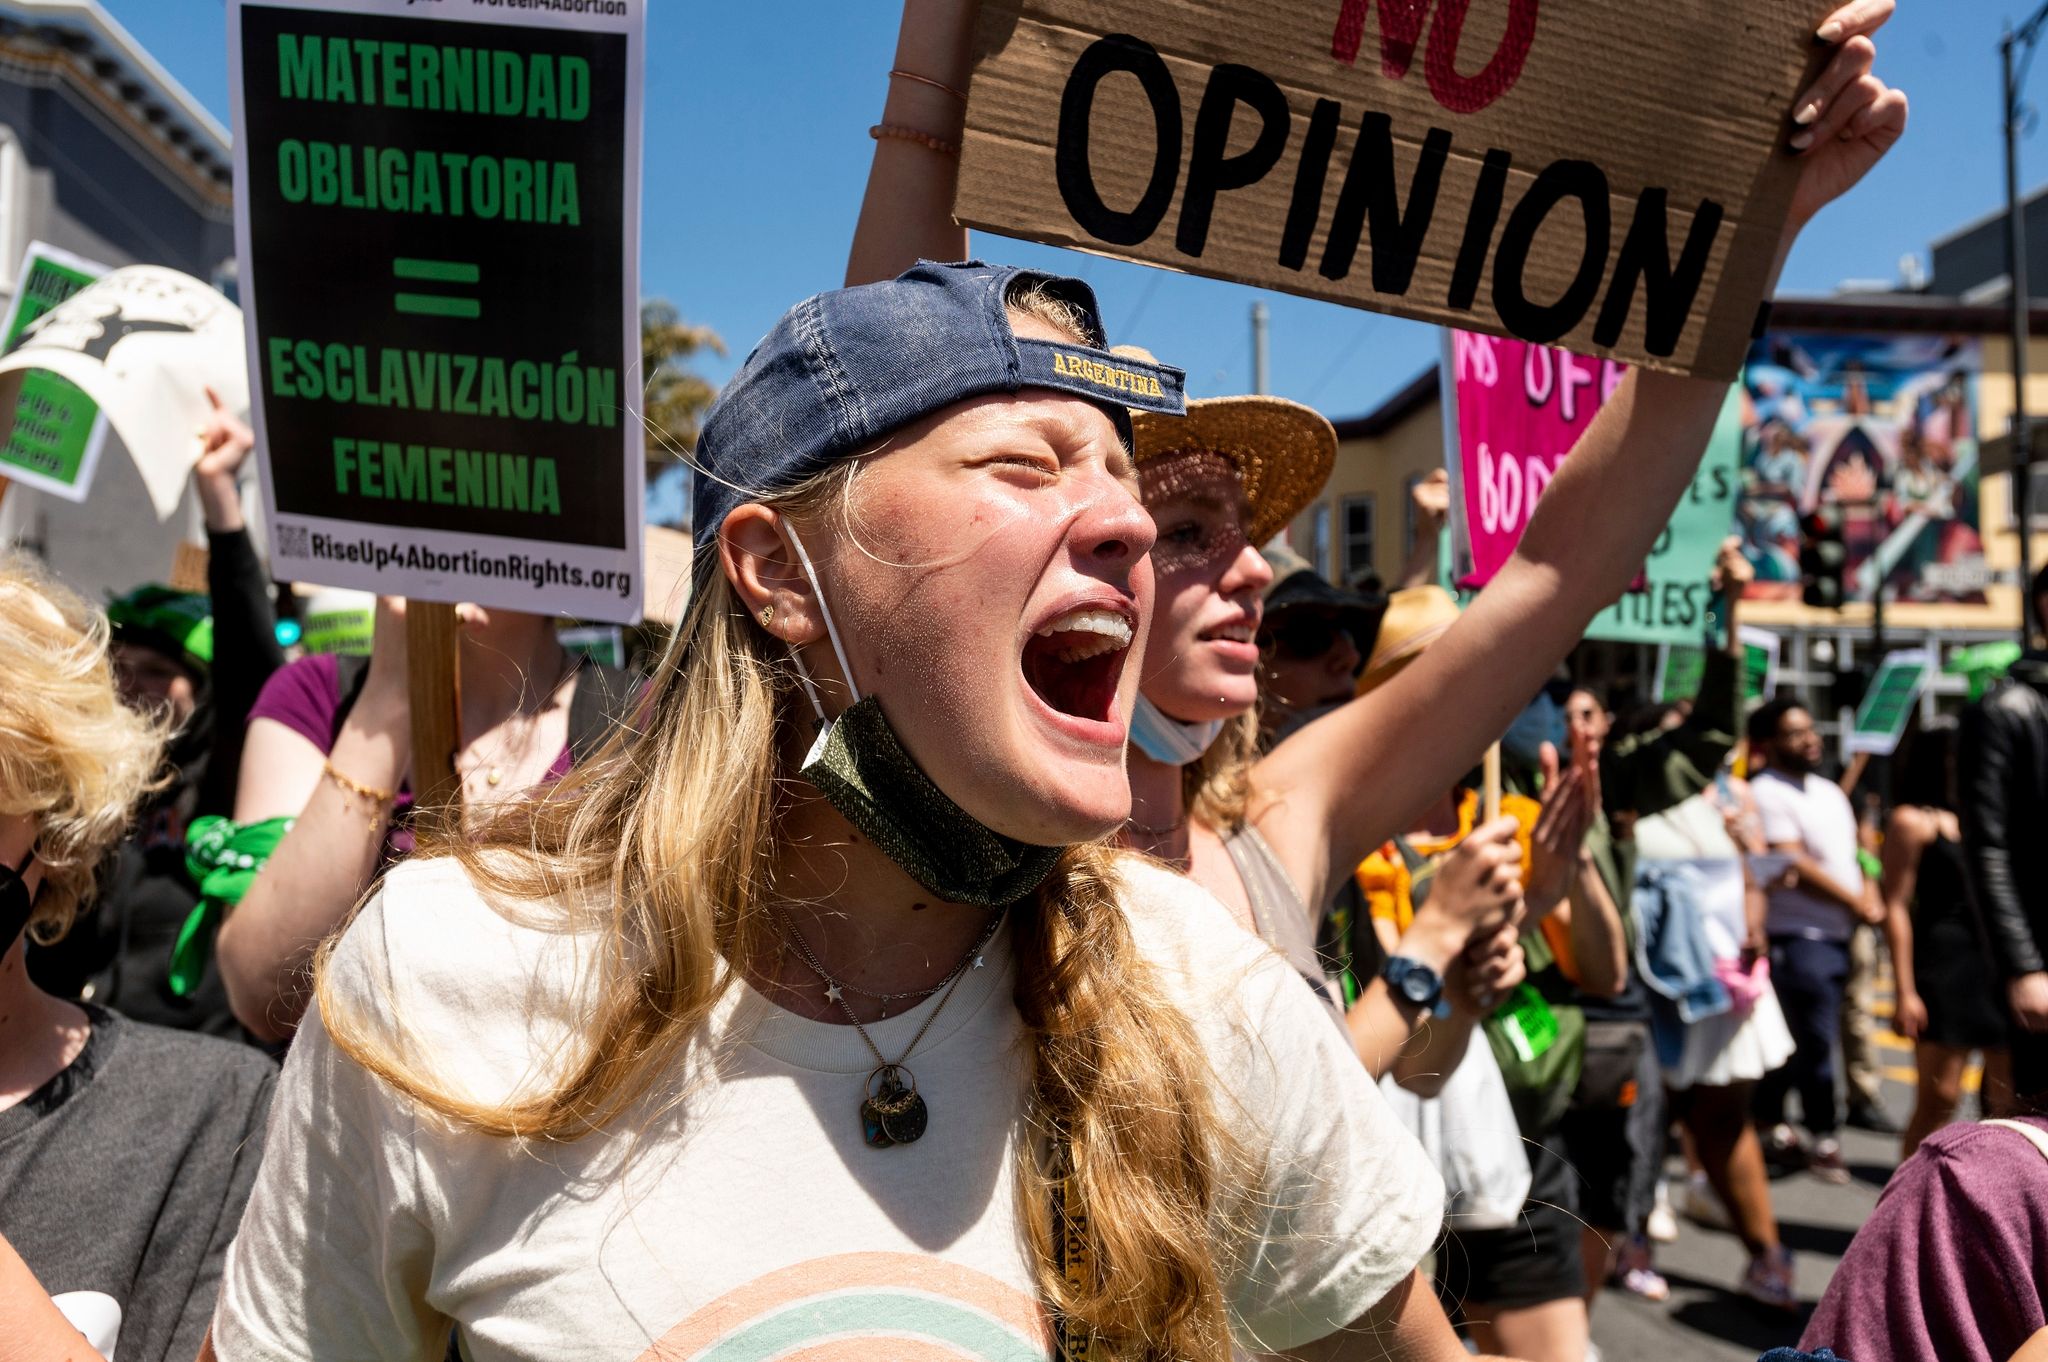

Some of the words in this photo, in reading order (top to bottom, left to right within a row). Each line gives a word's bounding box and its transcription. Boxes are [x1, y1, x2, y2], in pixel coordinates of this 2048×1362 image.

[278, 33, 590, 121] MATERNIDAD
[1330, 0, 1537, 116] NO
[278, 139, 581, 226] OBLIGATORIA
[1054, 32, 1724, 358] OPINION
[269, 337, 616, 427] ESCLAVIZACIÓN
[1053, 352, 1166, 398] ARGENTINA
[333, 438, 561, 515] FEMENINA
[311, 532, 631, 599] RiseUp4AbortionRights.org
